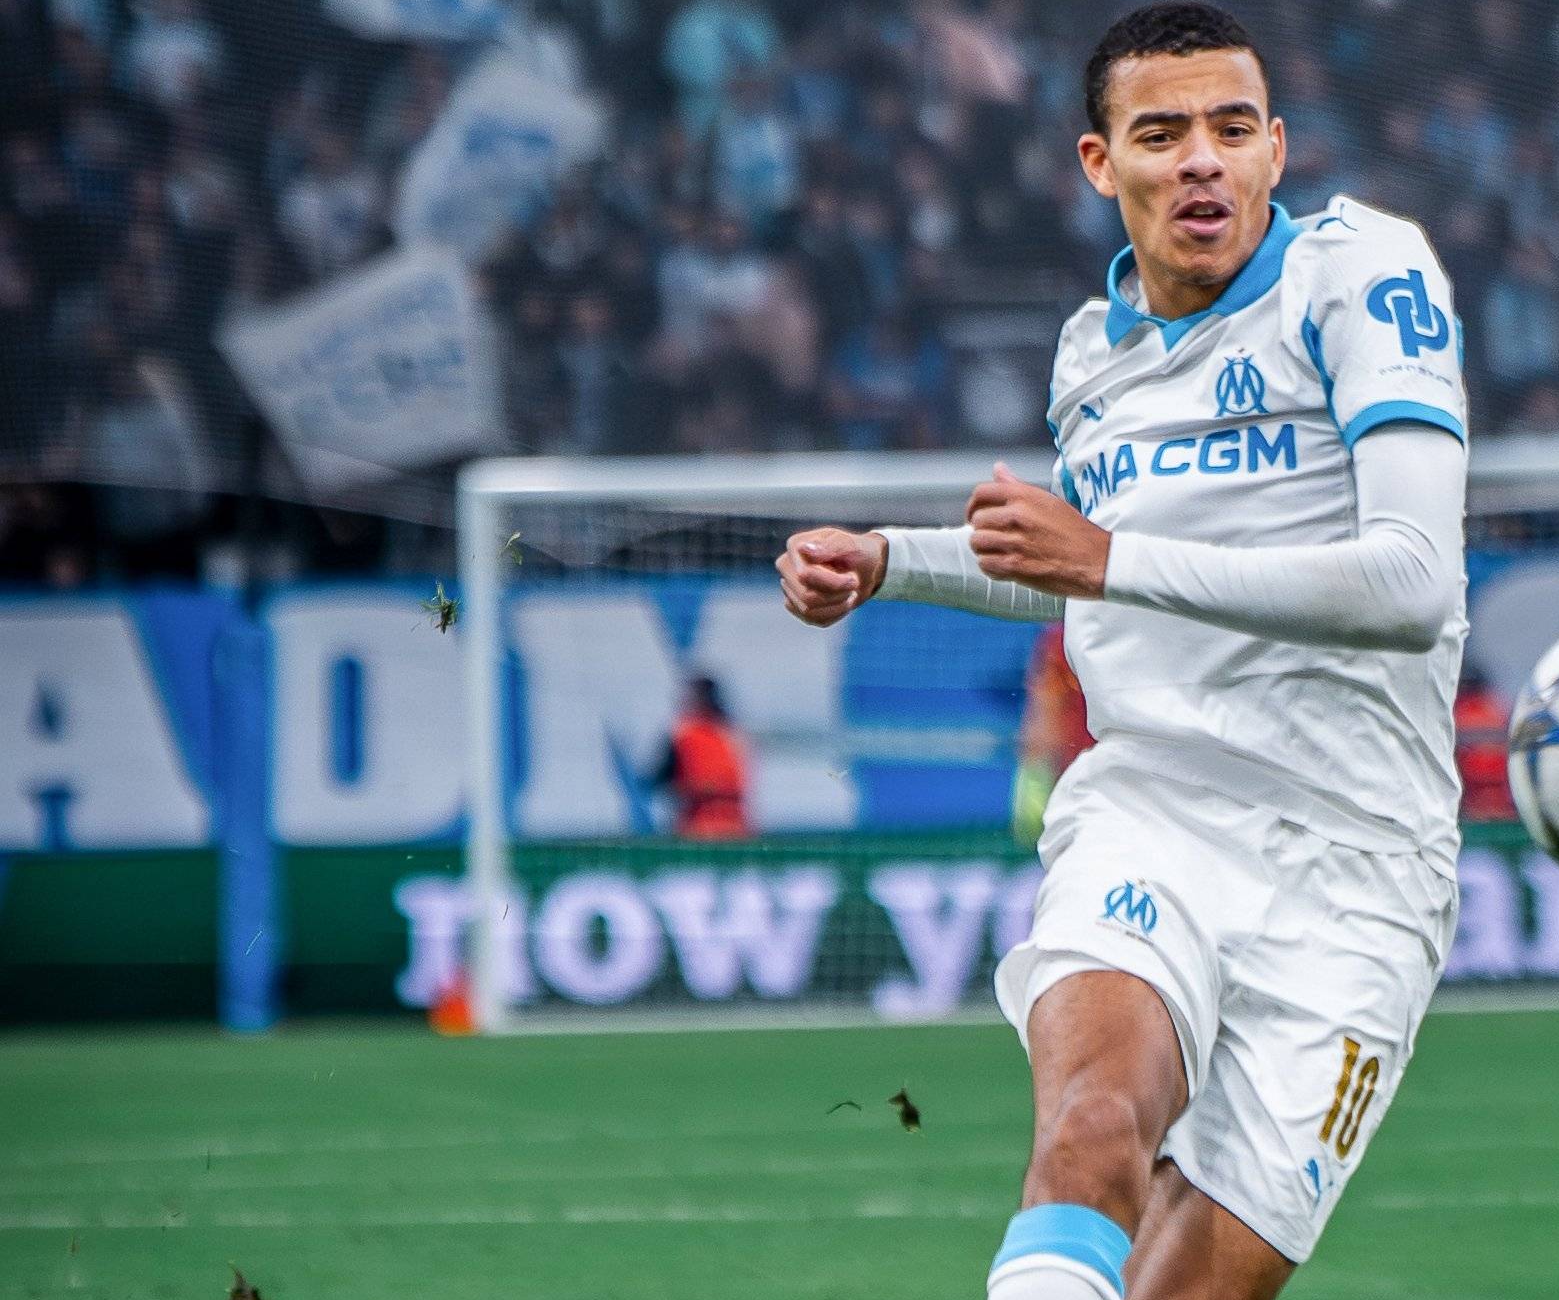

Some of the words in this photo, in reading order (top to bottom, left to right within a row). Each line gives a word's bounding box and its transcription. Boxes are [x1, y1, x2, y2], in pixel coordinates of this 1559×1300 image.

[1081, 443, 1138, 517] CMA
[1150, 423, 1298, 476] CGM
[1318, 1036, 1380, 1160] 10
